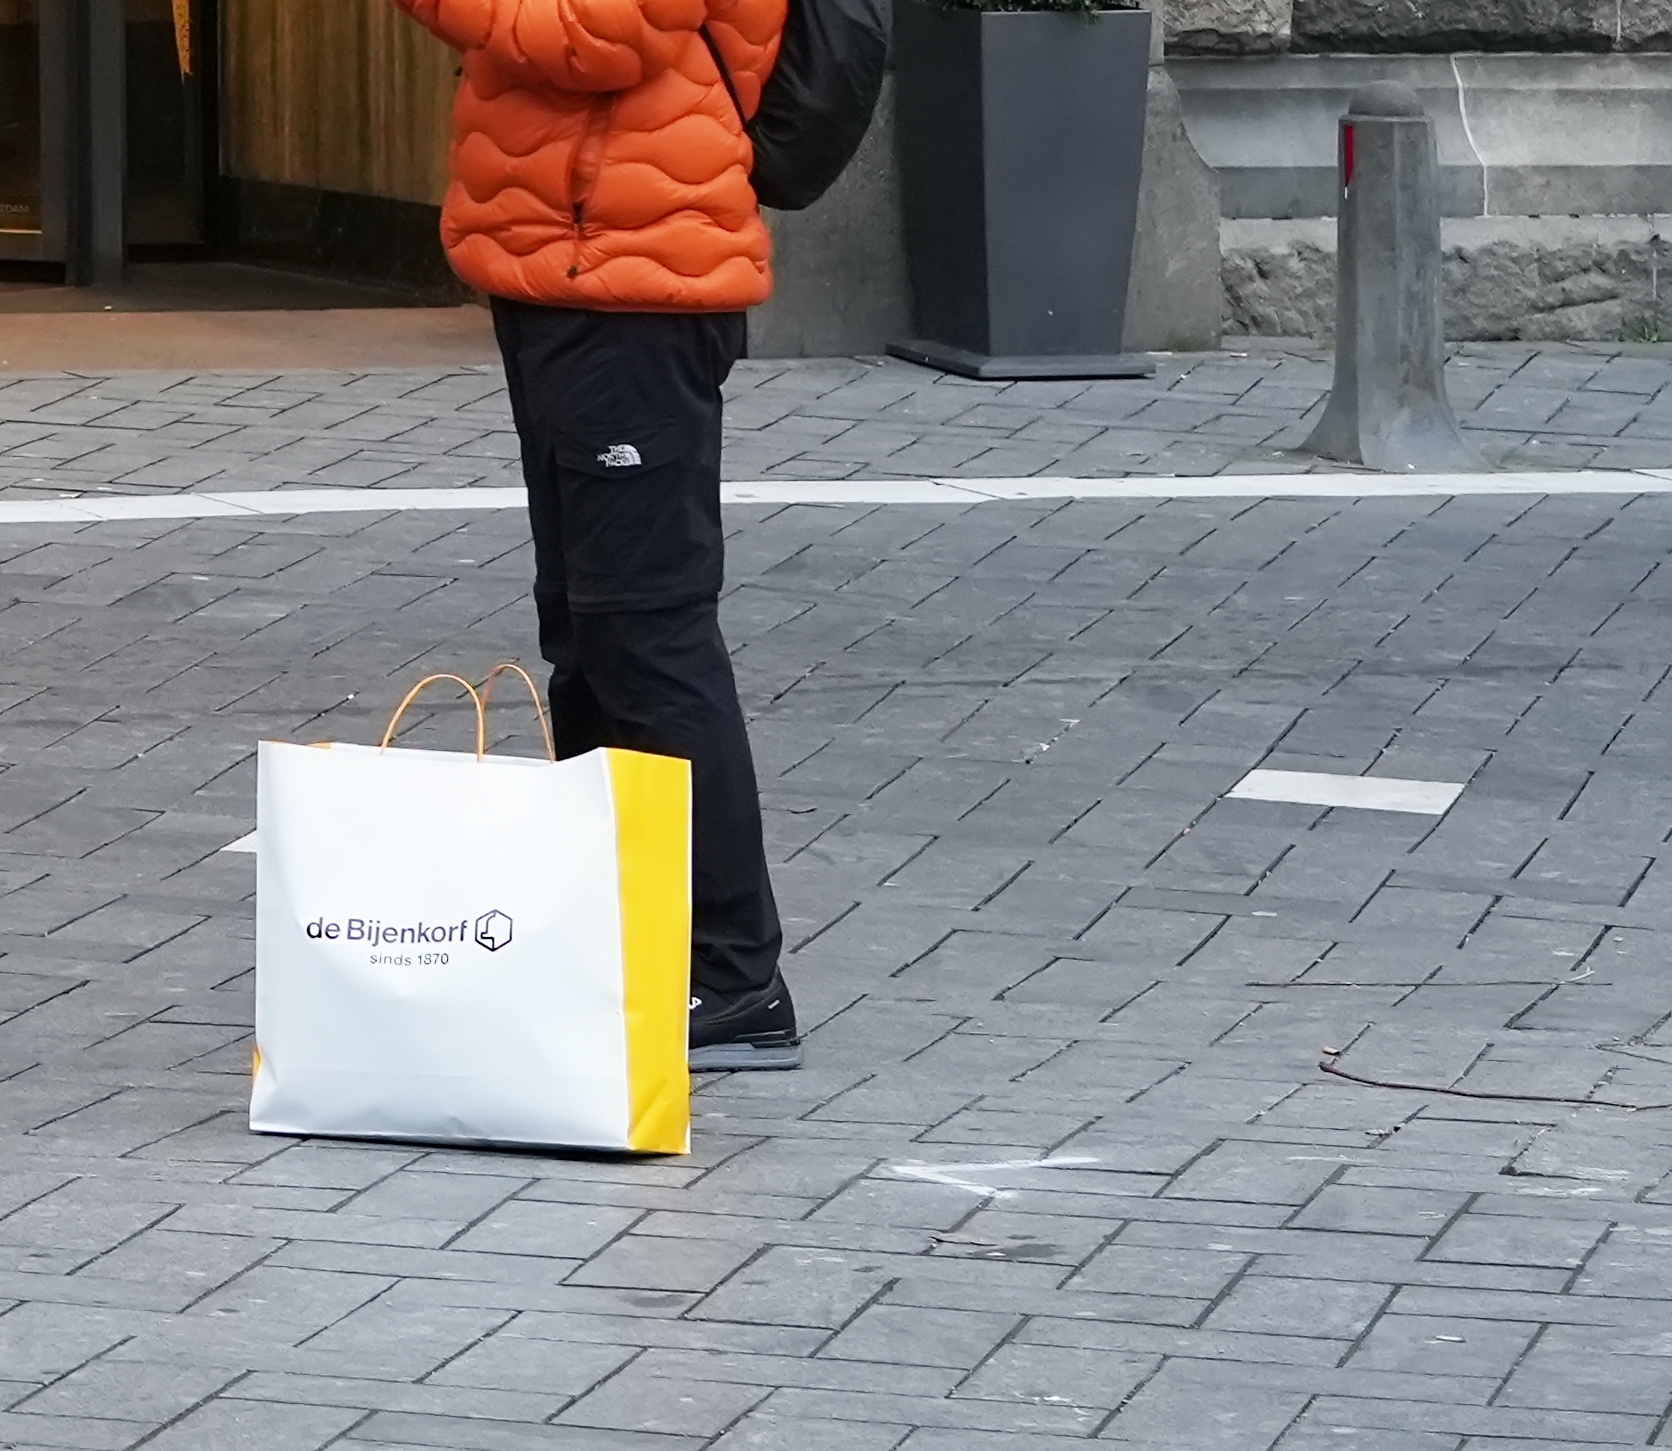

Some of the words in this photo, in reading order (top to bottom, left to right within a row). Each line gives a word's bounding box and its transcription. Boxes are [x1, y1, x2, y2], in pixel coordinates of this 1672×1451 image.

[306, 917, 341, 940] de
[347, 918, 469, 947] Bijenkorf
[369, 953, 413, 967] sinds
[417, 953, 450, 966] 1870
